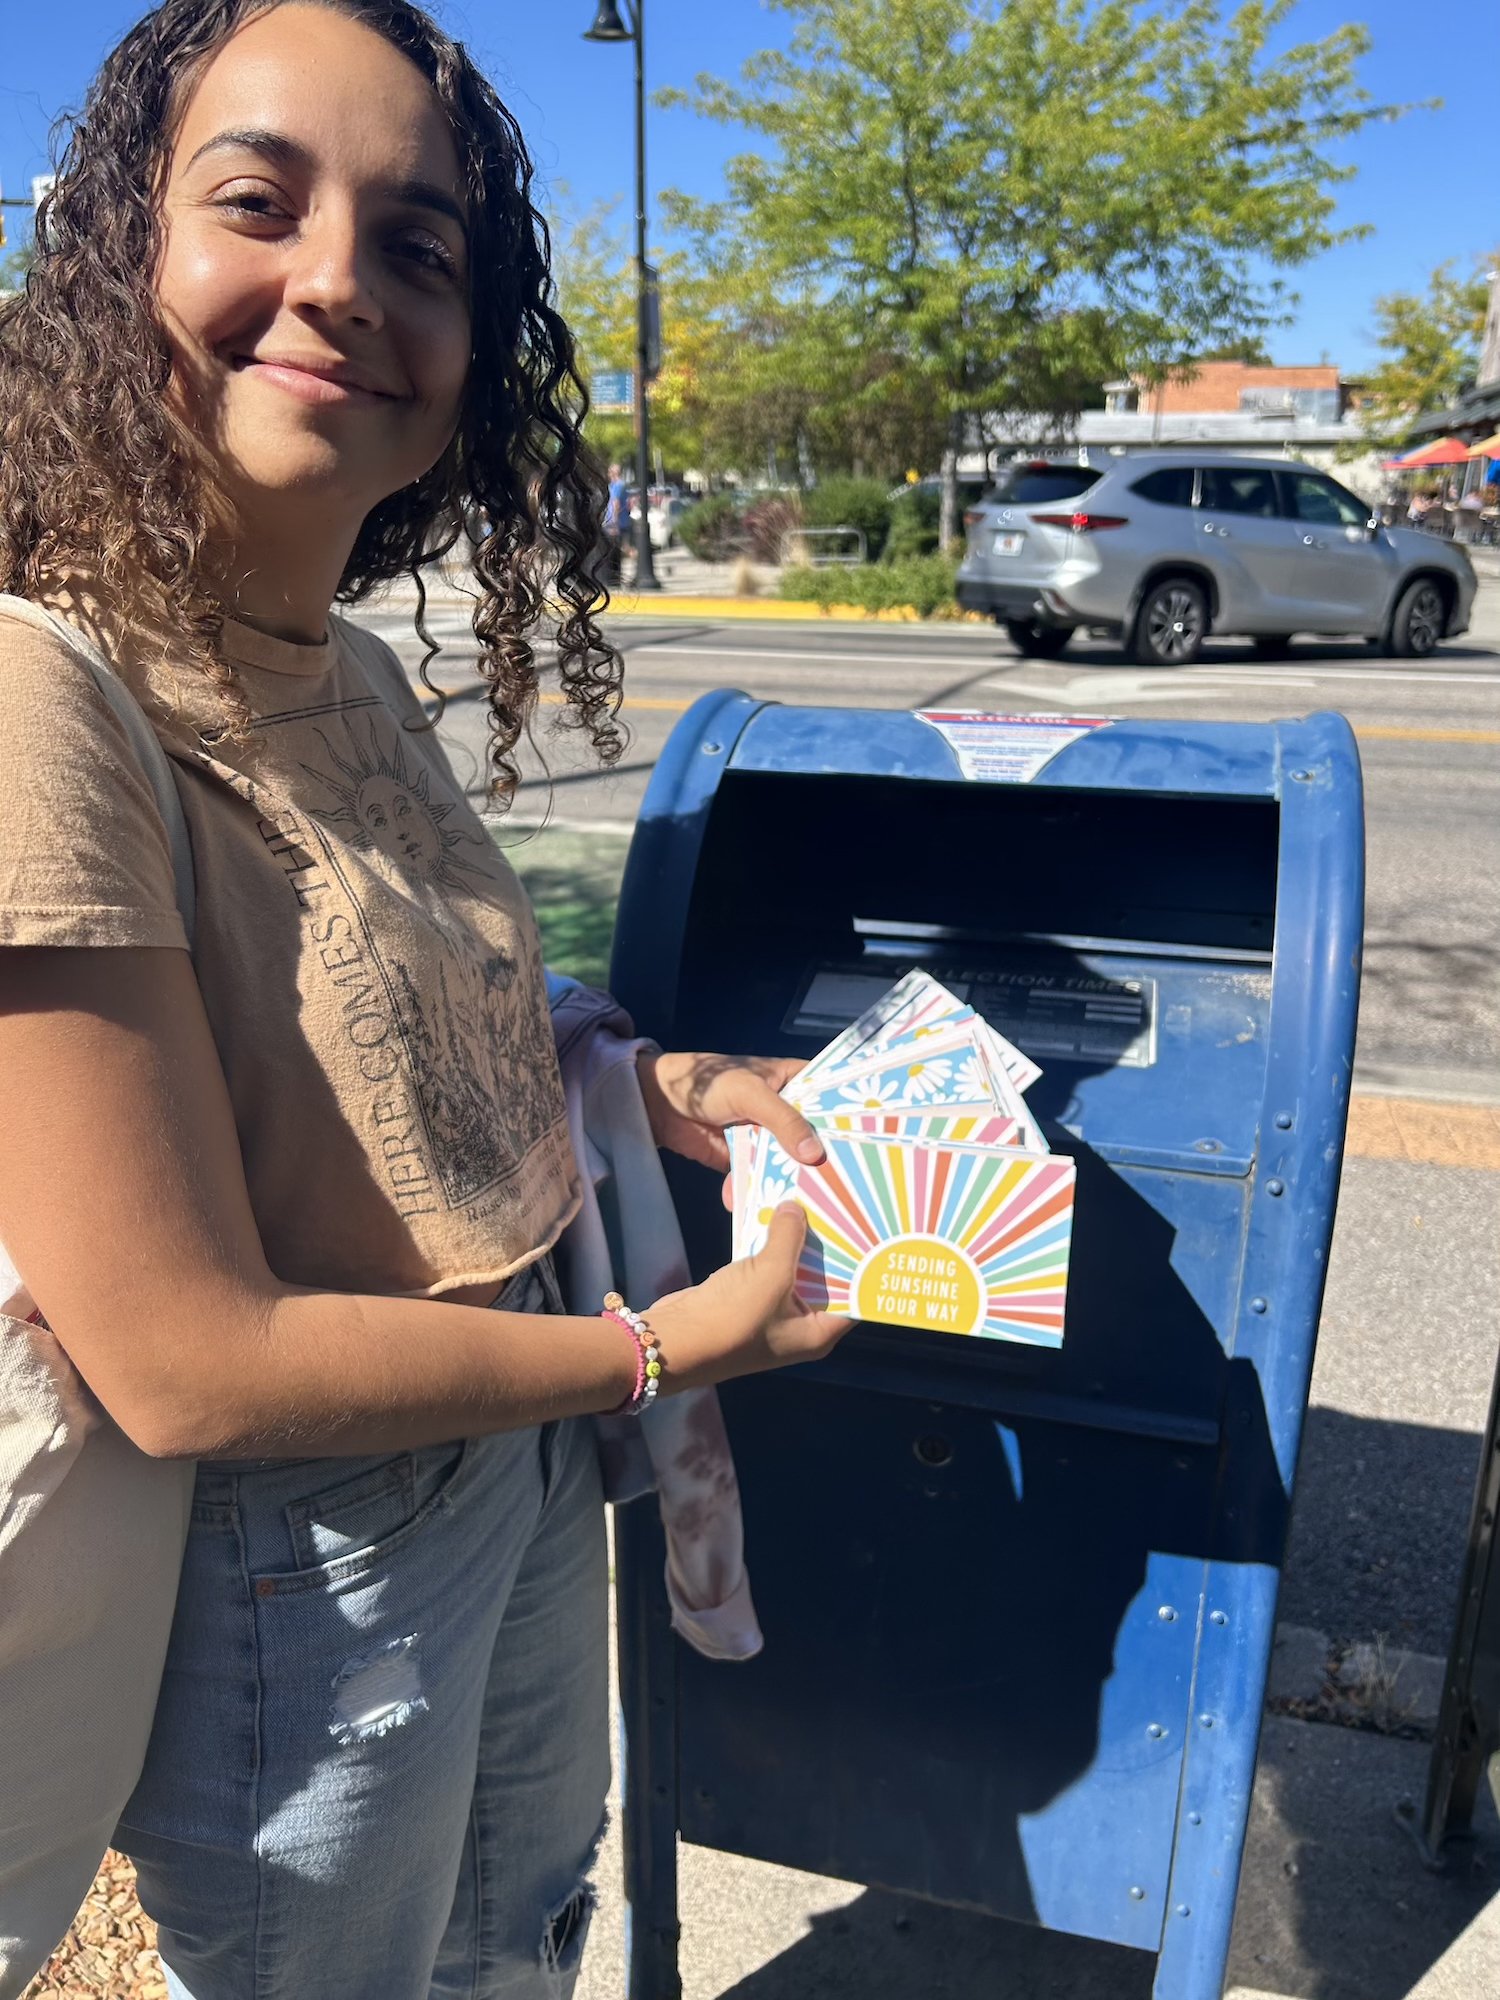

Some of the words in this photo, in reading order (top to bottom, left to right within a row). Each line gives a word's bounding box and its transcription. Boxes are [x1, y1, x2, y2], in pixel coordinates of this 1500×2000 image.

[256, 810, 331, 907] THE
[894, 965, 1056, 987] CLLECTION
[1065, 977, 1142, 993] TIMES
[310, 914, 399, 1082] COMES
[372, 1092, 438, 1221] HERE
[888, 1252, 957, 1278] SENDING
[880, 1273, 959, 1300] SUNSHINE
[876, 1294, 917, 1318] YOUR
[926, 1301, 959, 1323] WAY
